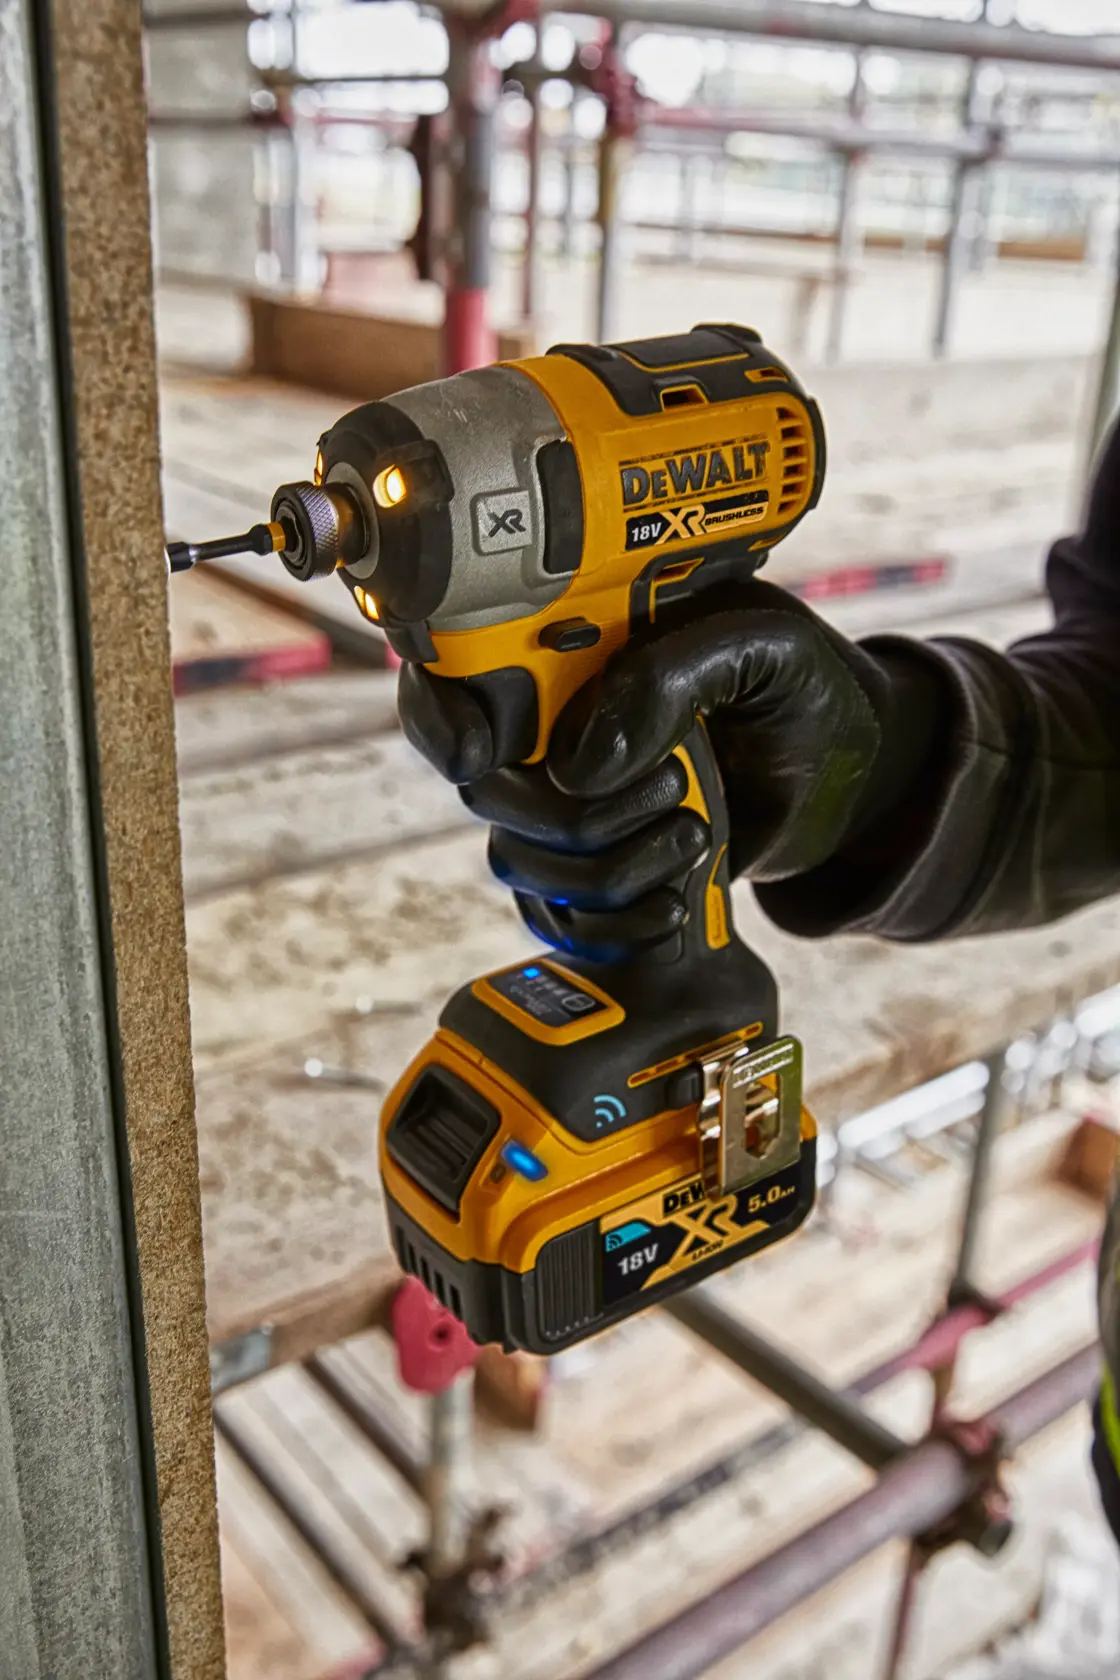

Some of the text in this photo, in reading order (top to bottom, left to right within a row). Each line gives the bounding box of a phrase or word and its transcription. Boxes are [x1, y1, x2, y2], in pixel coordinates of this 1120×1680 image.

[488, 509, 526, 537] XR
[632, 503, 764, 545] 18V XR BRUSHLESS
[617, 1194, 742, 1275] 18V XR
